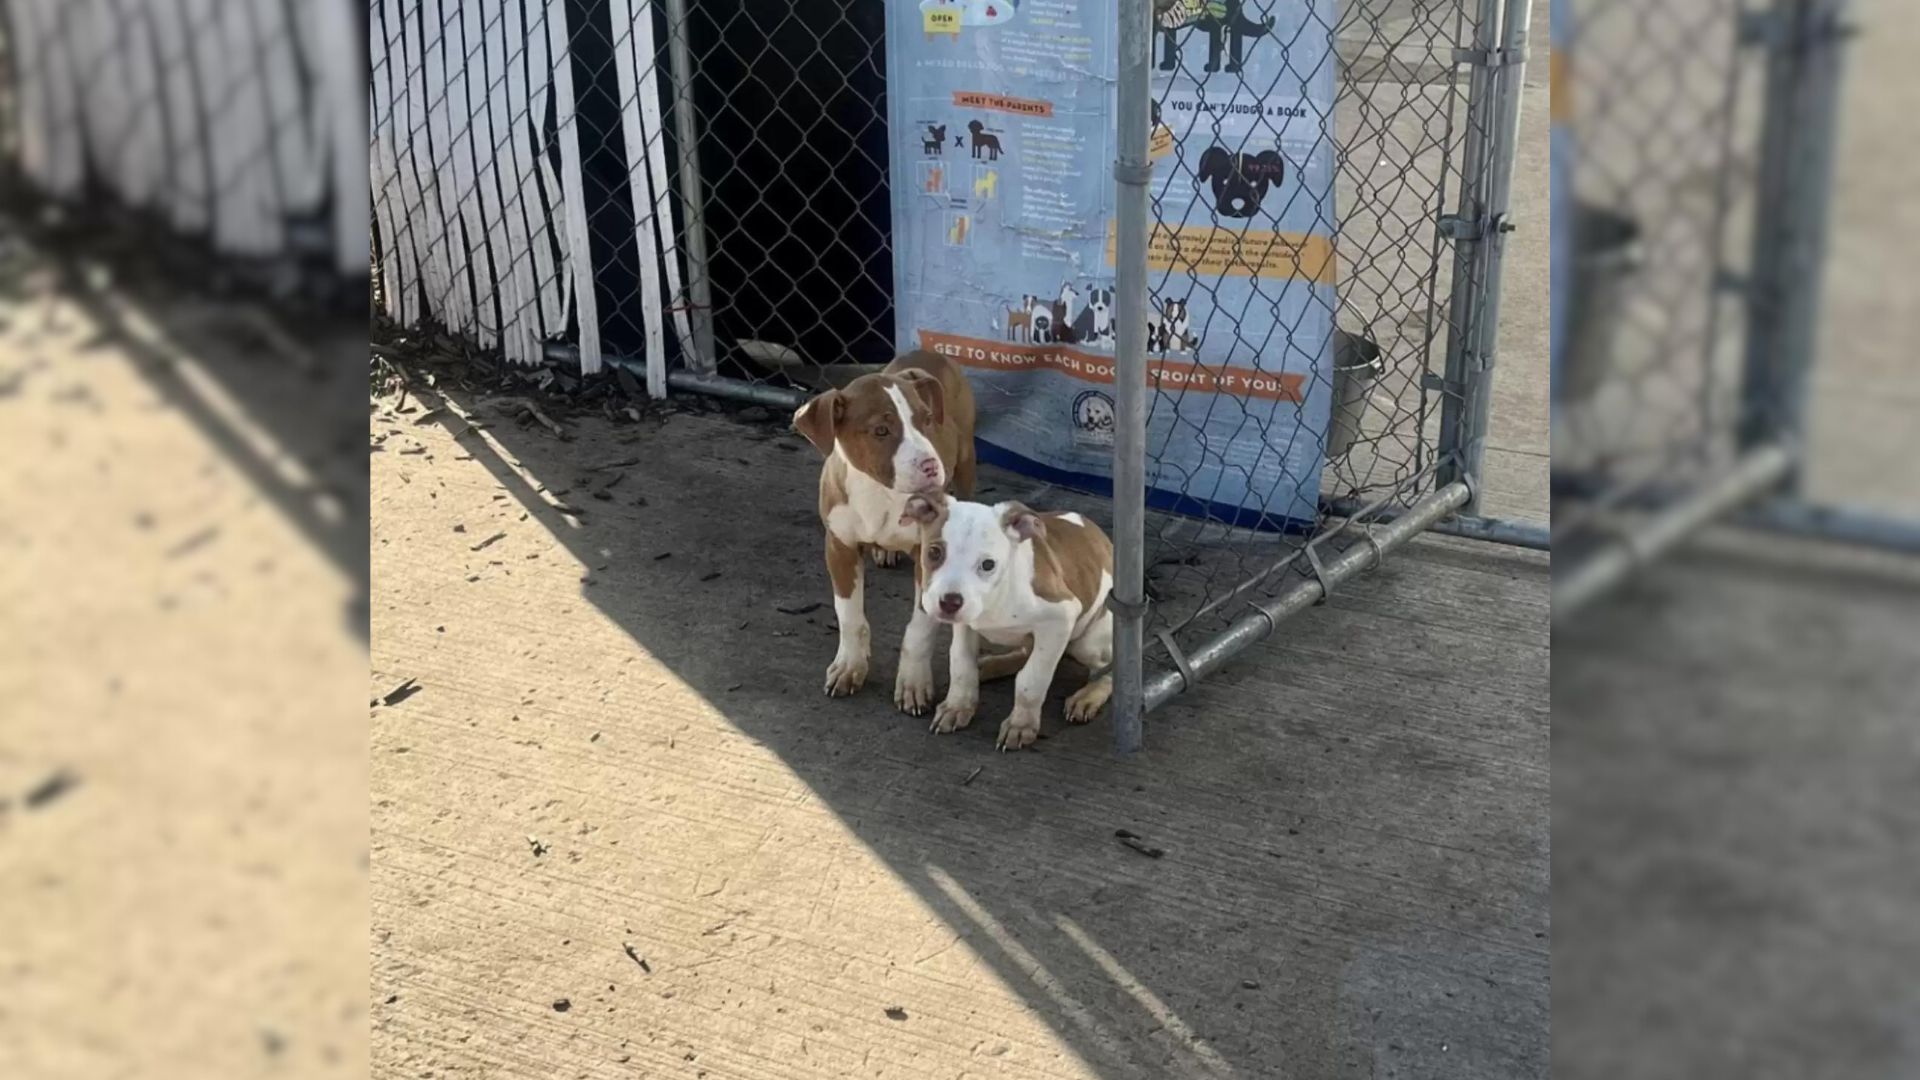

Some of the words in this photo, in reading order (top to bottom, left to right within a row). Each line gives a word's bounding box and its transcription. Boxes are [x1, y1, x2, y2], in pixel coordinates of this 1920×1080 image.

[931, 14, 953, 22] OPEN
[961, 96, 986, 104] MEET
[989, 99, 1005, 107] THE
[1007, 102, 1045, 113] PARENTS
[1171, 101, 1193, 111] YOU
[1196, 102, 1226, 113] CAN'T
[1267, 106, 1274, 116] A
[1277, 106, 1307, 118] BOOK
[1163, 233, 1206, 244] aurately
[934, 343, 961, 357] GET
[967, 347, 986, 360] TO
[990, 351, 1036, 364] KNOW
[1043, 353, 1081, 370] EACH
[1150, 368, 1206, 384] FRONT
[1212, 376, 1235, 386] OF
